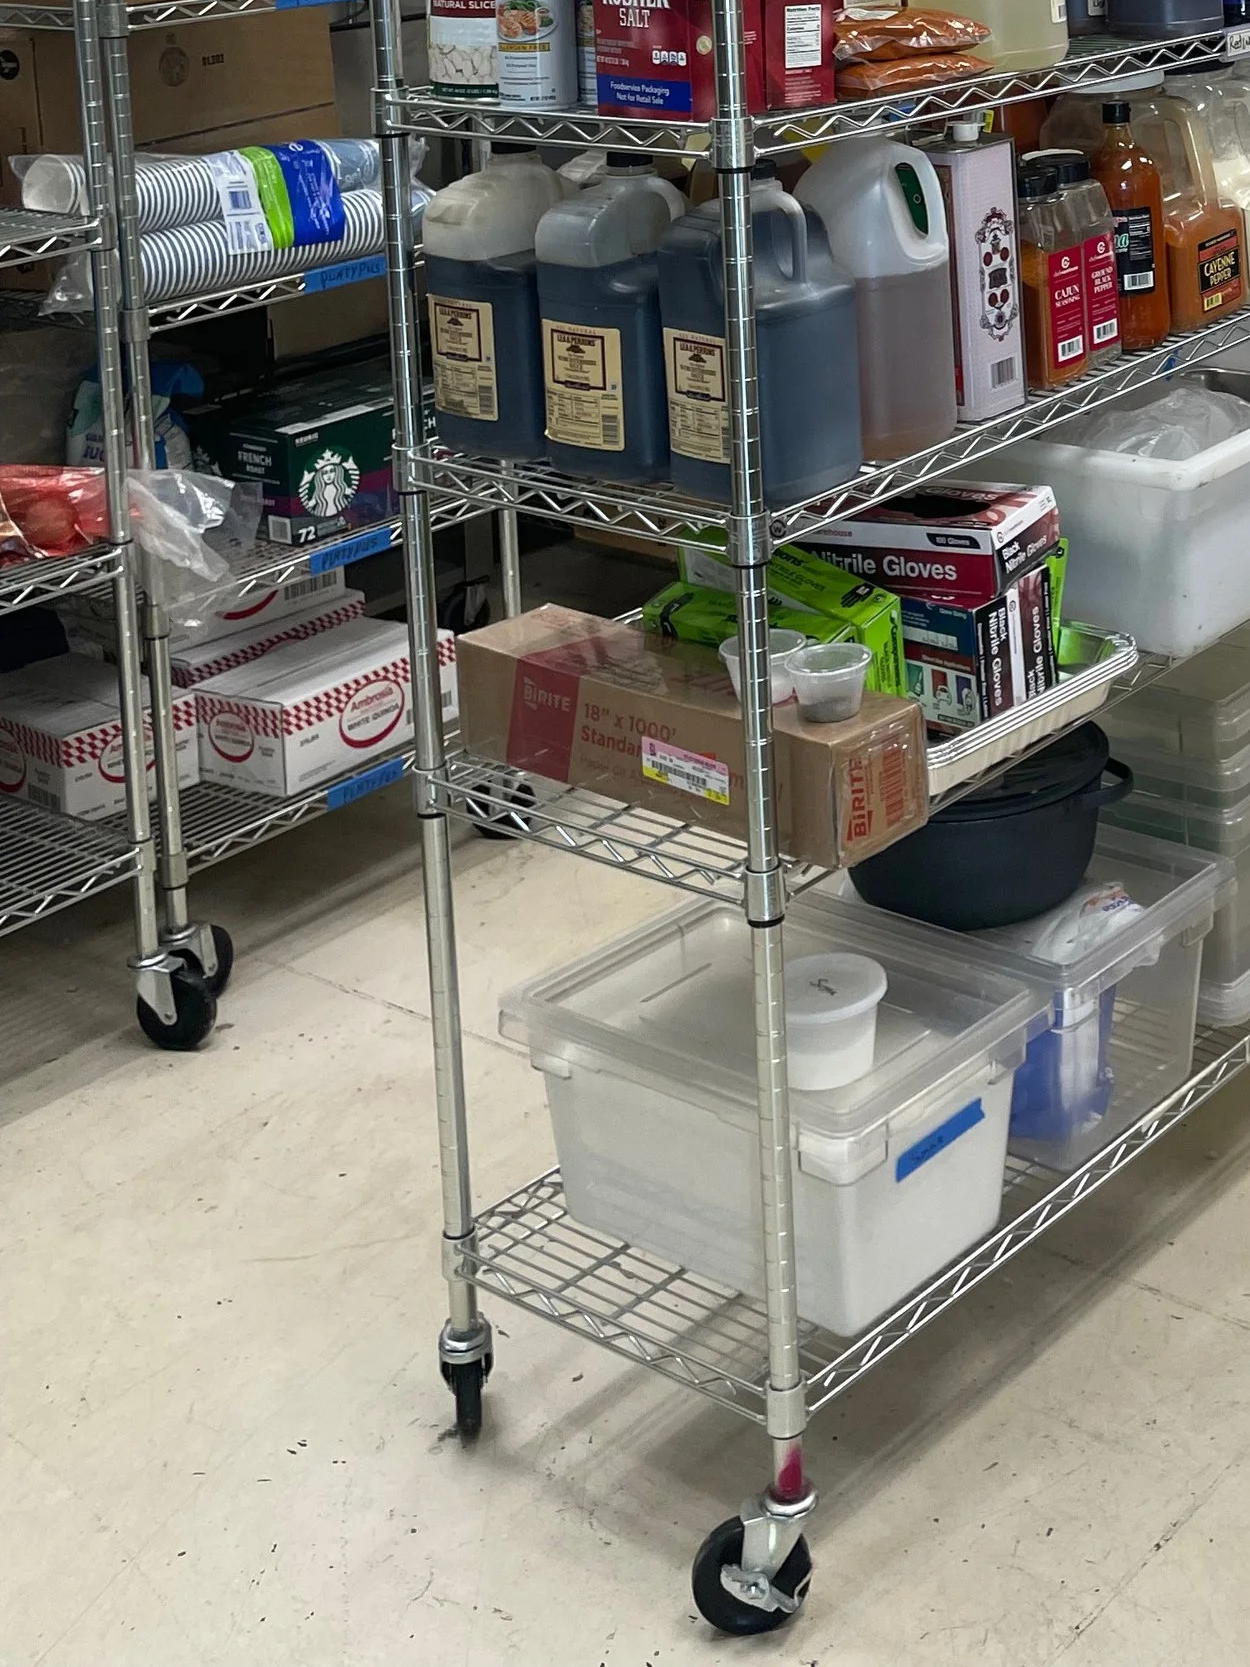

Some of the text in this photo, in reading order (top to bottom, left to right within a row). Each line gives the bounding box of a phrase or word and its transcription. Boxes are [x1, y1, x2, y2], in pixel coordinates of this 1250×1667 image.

[433, 0, 496, 10] NATURAL SLICE
[619, 8, 650, 28] SALT
[1091, 266, 1113, 279] GROUND
[1204, 251, 1236, 277] CAYENNE
[1095, 275, 1112, 286] BLACK
[1210, 268, 1232, 286] PEPPER
[1055, 284, 1080, 300] CAJUN
[1094, 282, 1113, 294] PEPPER
[238, 450, 272, 467] FRENCH
[298, 525, 316, 543] 72
[946, 537, 970, 546] Gloves
[1002, 540, 1021, 560] Black
[1005, 534, 1048, 575] Nitrile Gloves
[882, 555, 958, 580] Gloves
[998, 607, 1008, 642] Black
[1032, 606, 1043, 654] Gloves
[988, 611, 1003, 707] Nitrile Gloves
[350, 686, 394, 712] Ambrosia
[584, 702, 610, 721] 18"
[614, 716, 624, 728] x
[581, 725, 642, 758] Standar
